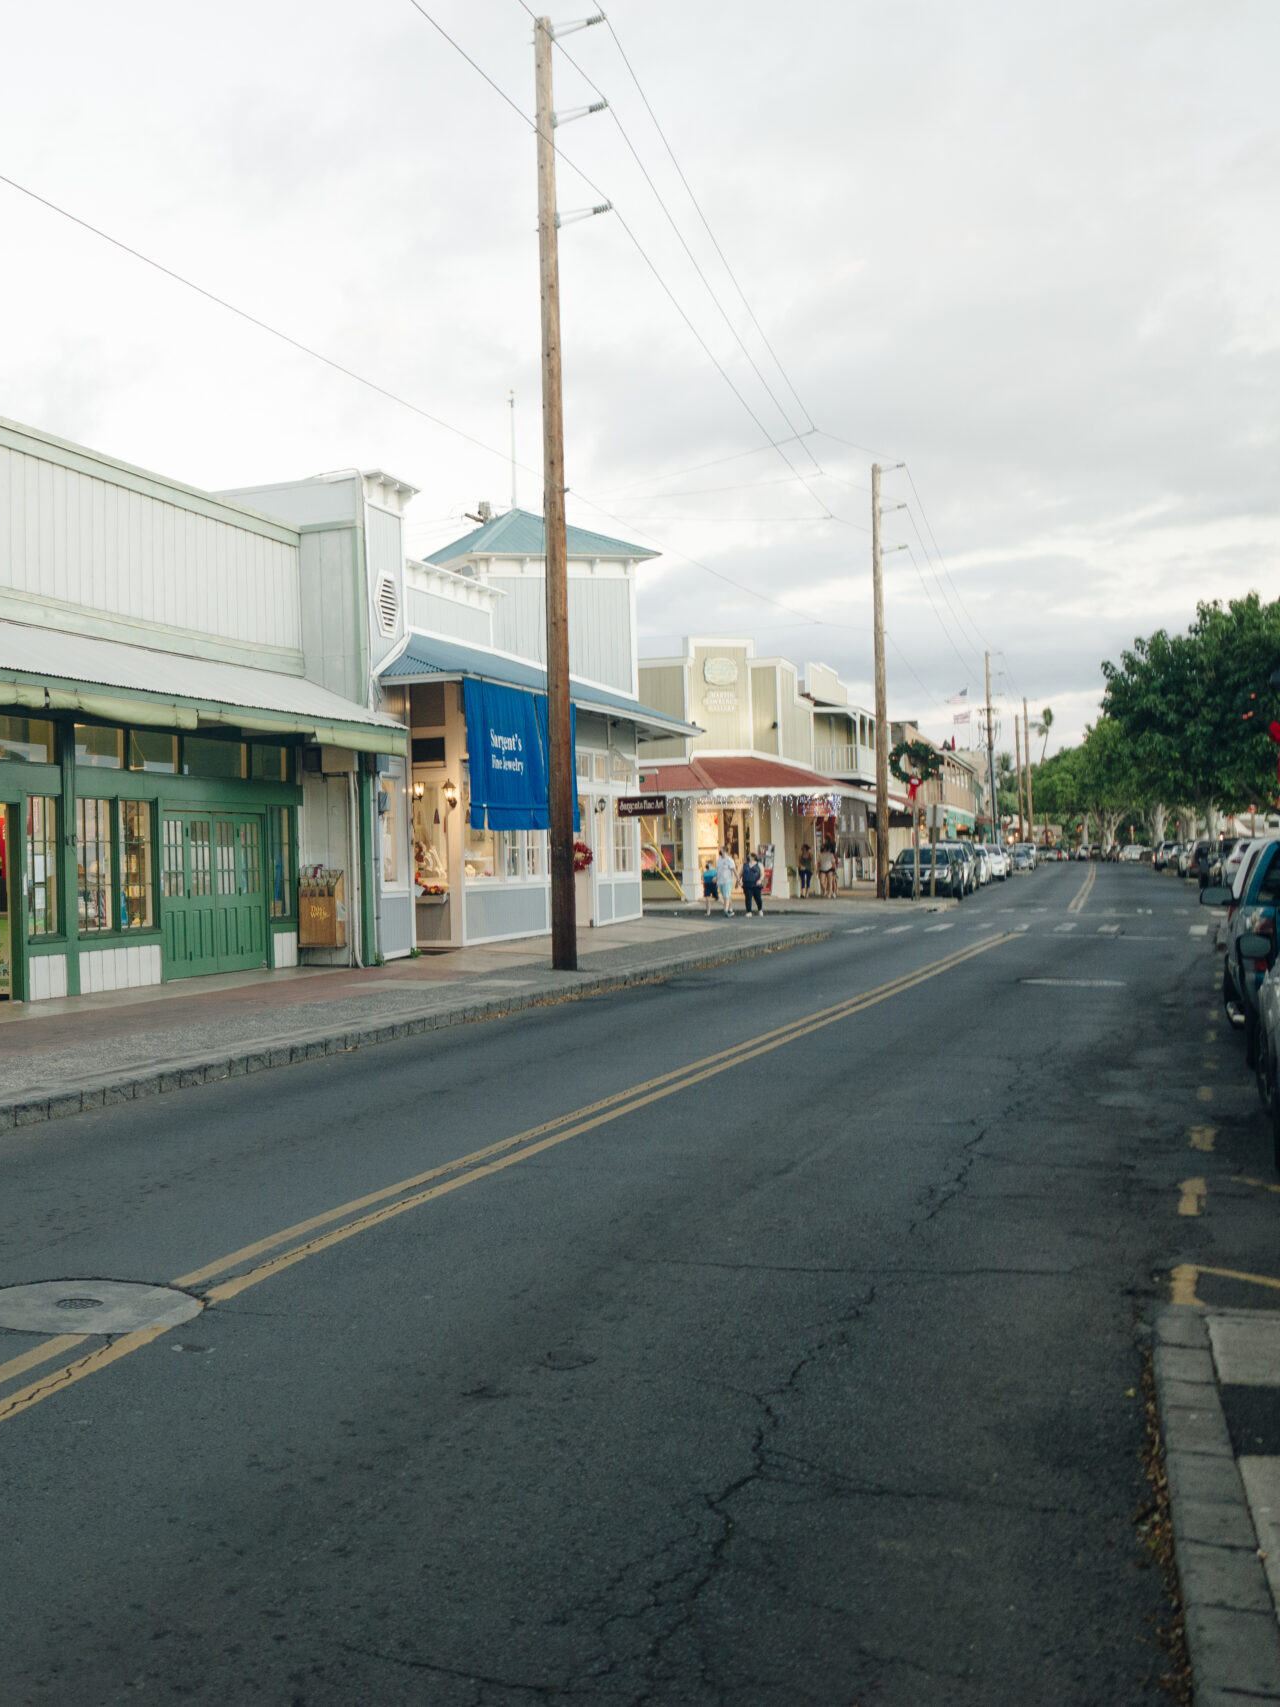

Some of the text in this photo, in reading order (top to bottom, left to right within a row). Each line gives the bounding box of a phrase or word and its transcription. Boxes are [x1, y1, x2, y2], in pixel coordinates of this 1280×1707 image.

[489, 728, 523, 755] Sargent's
[491, 754, 524, 776] Fine Jewelry
